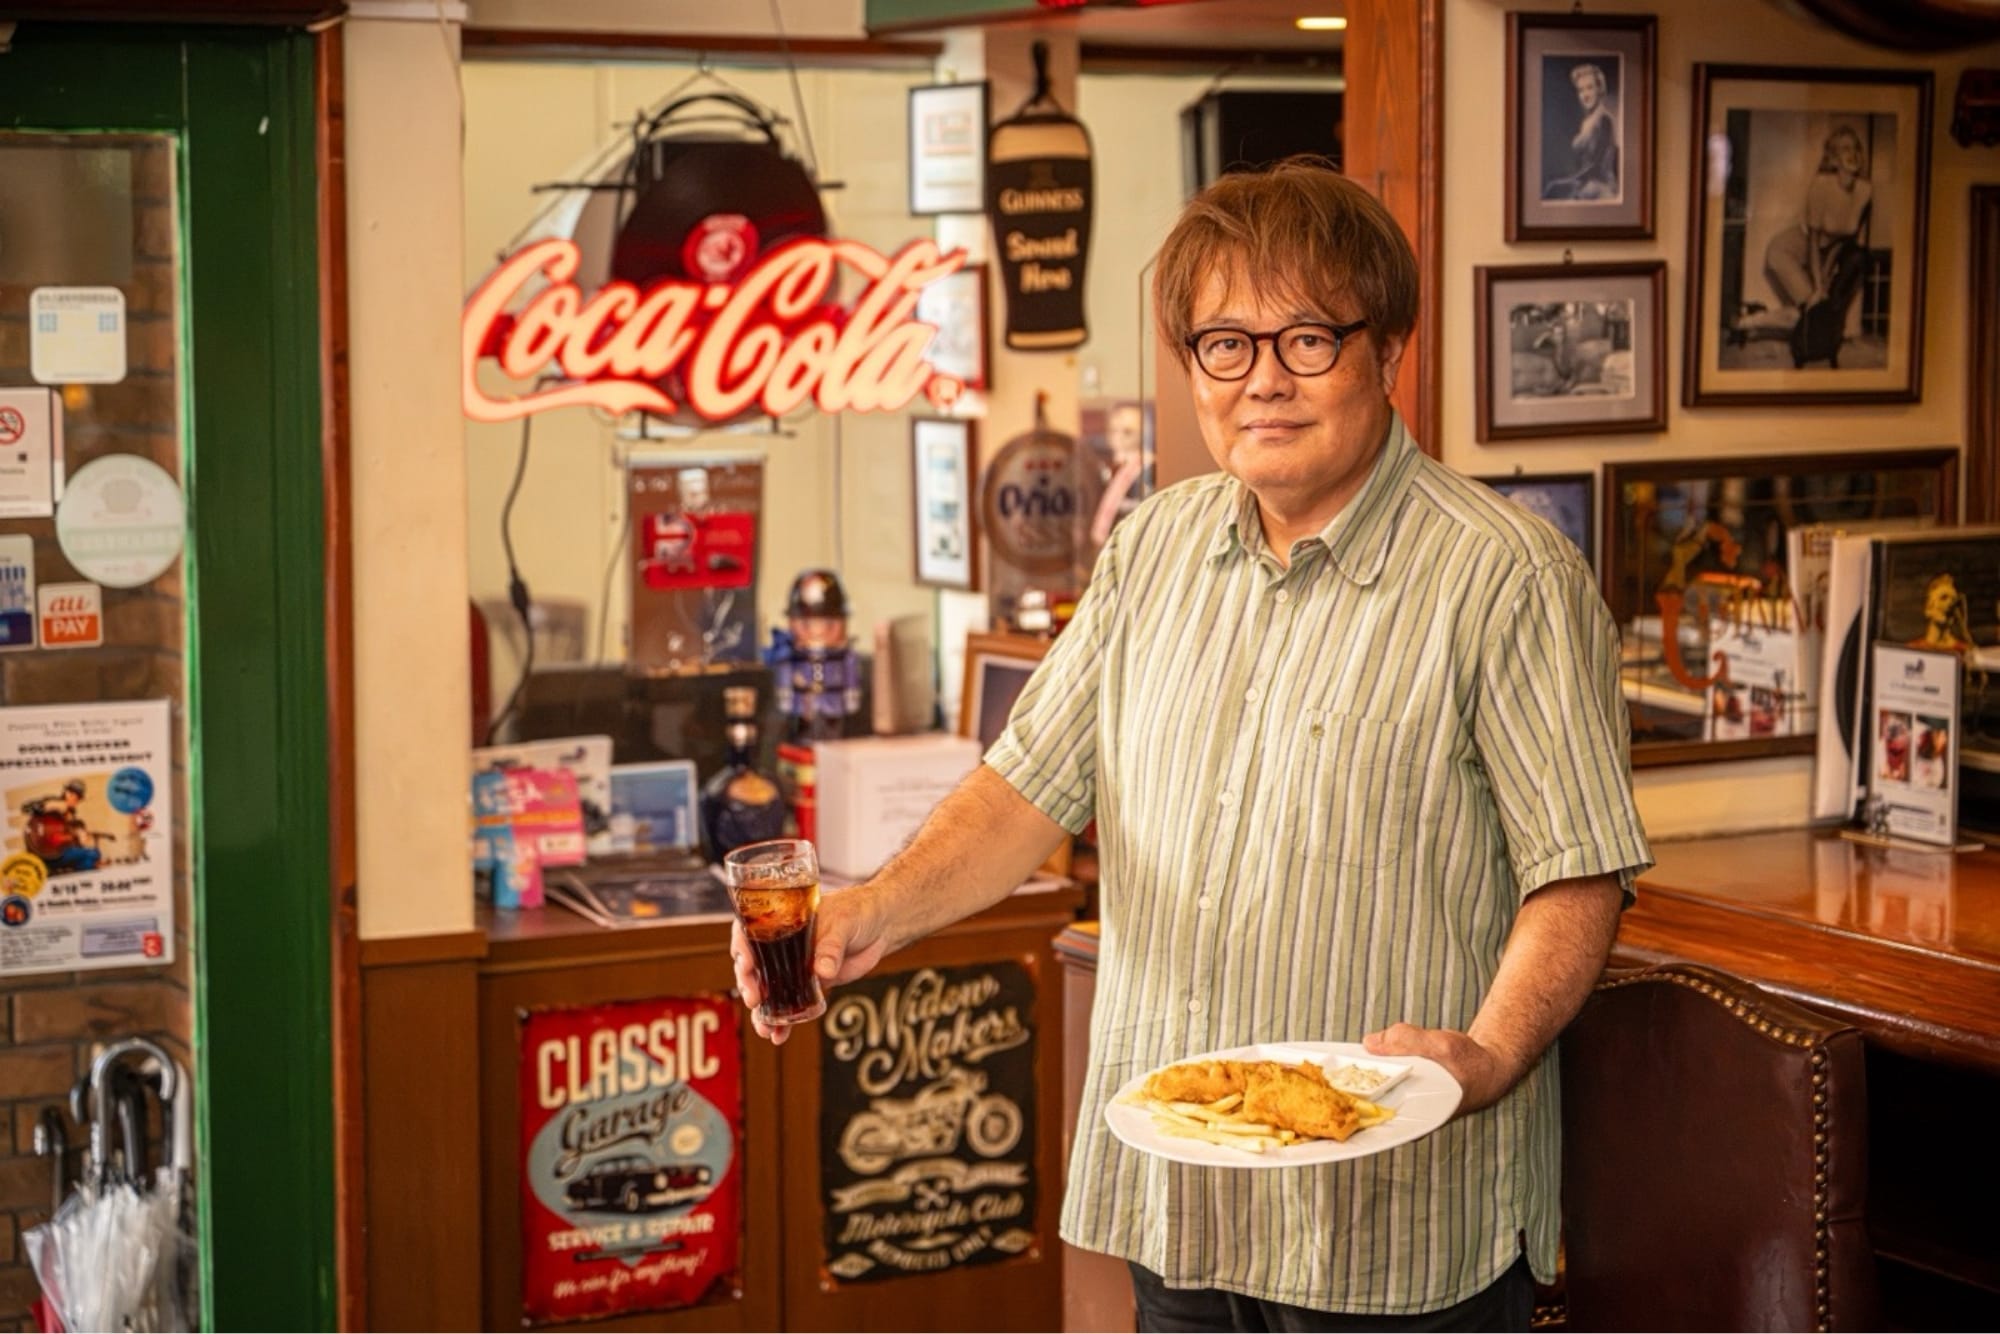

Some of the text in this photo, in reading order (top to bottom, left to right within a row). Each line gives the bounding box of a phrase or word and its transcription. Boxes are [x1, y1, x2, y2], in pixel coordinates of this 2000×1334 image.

[1000, 188, 1084, 214] GUINNESS
[1020, 263, 1072, 293] Here
[49, 595, 85, 613] au
[51, 617, 91, 637] PAY
[537, 1010, 720, 1109] CLASSIC
[856, 1006, 1030, 1096] Makers
[553, 1088, 692, 1180] Garage
[548, 1223, 623, 1251] SERVICE
[646, 1213, 715, 1237] REPAIR
[838, 1191, 1024, 1244] Motorcycle Club
